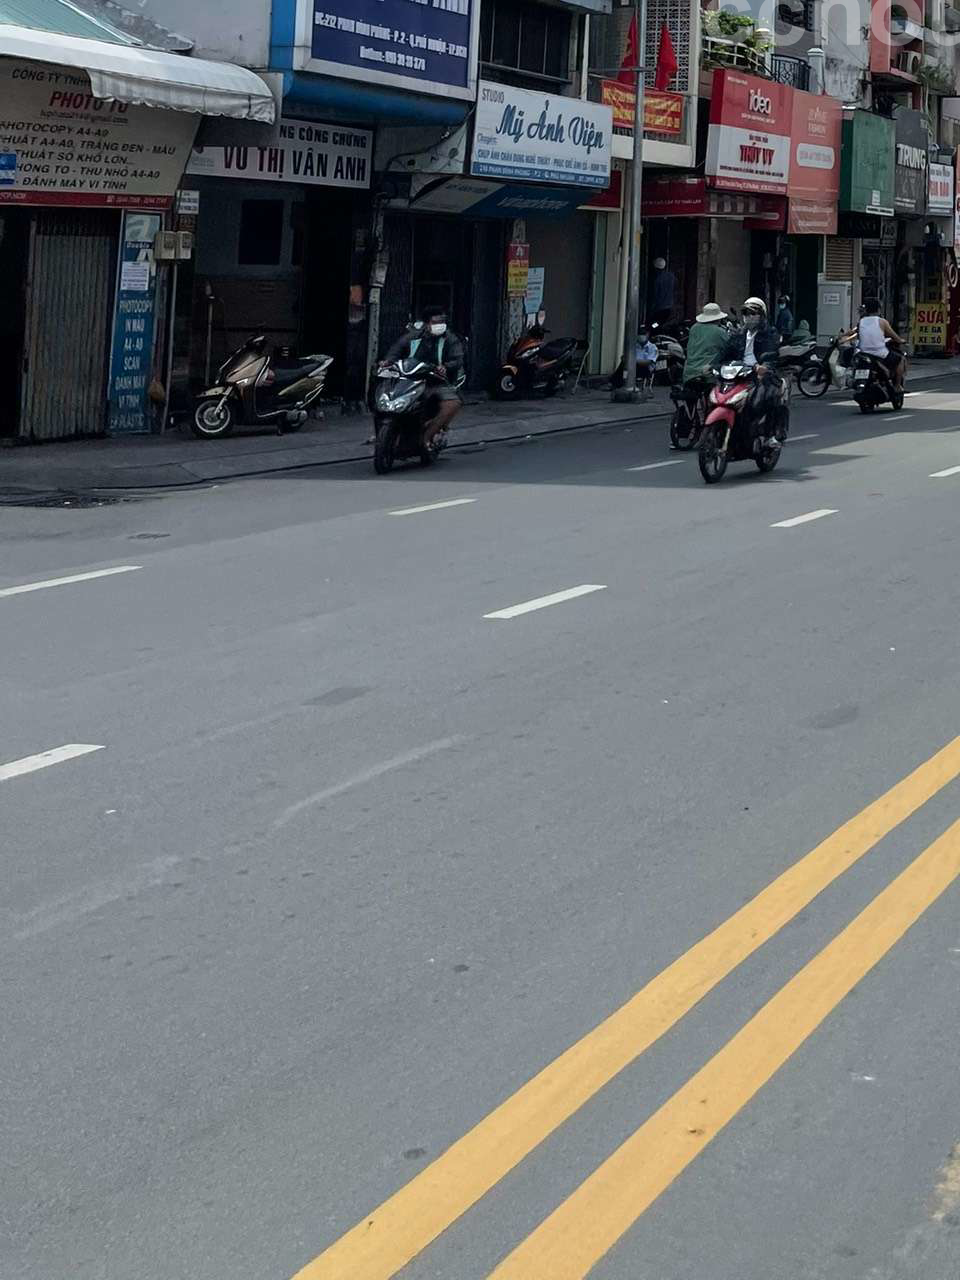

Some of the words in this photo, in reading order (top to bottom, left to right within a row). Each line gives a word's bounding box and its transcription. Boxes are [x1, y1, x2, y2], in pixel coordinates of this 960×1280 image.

[482, 87, 504, 104] STUDIO
[299, 126, 329, 144] CÔNG
[332, 129, 368, 149] CHỨNG
[257, 146, 285, 179] THỊ
[292, 147, 328, 178] VÂN
[333, 155, 367, 182] ANH
[896, 143, 926, 169] TRUNG
[119, 299, 153, 314] PHOTOCOPY
[124, 356, 140, 371] SCAN
